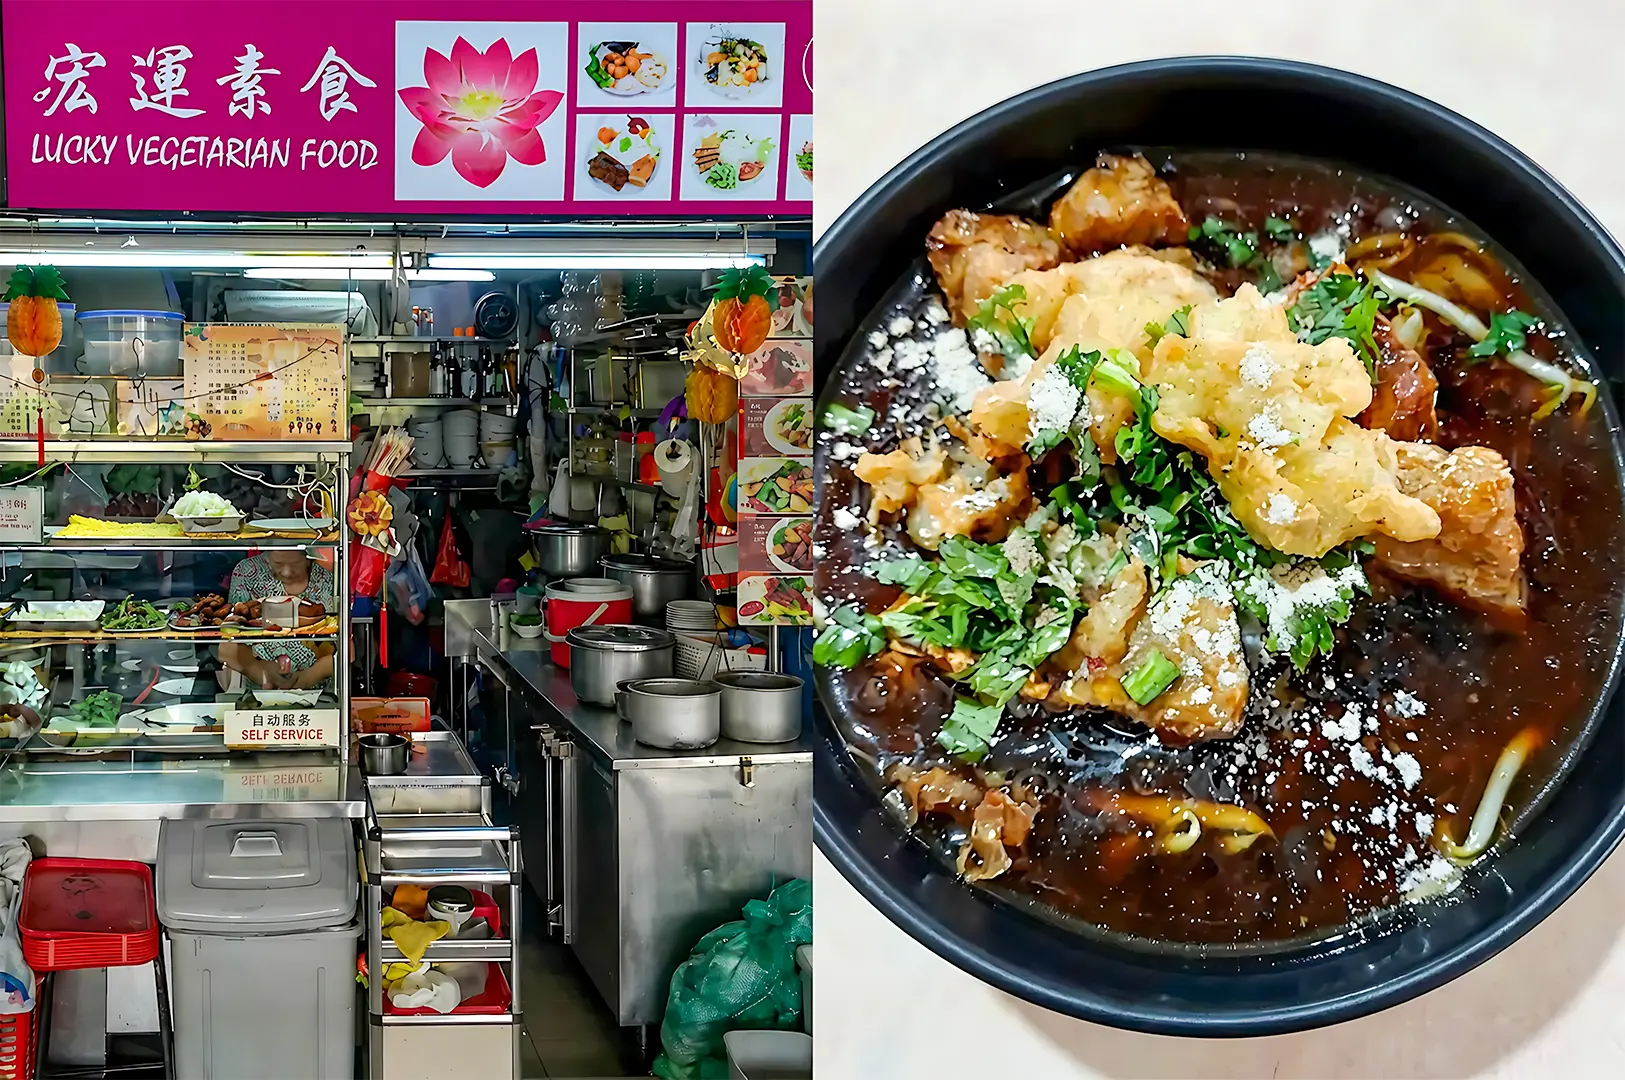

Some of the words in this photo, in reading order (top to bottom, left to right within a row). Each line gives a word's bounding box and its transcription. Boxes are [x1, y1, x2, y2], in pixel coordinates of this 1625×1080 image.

[32, 42, 378, 122] 宏運素食
[31, 133, 118, 165] LUCKY
[126, 135, 291, 171] VEGETARIAN
[300, 138, 379, 170] FOOD
[253, 713, 311, 727] 自动服务
[241, 729, 270, 741] SELF
[273, 728, 323, 740] SERVICE
